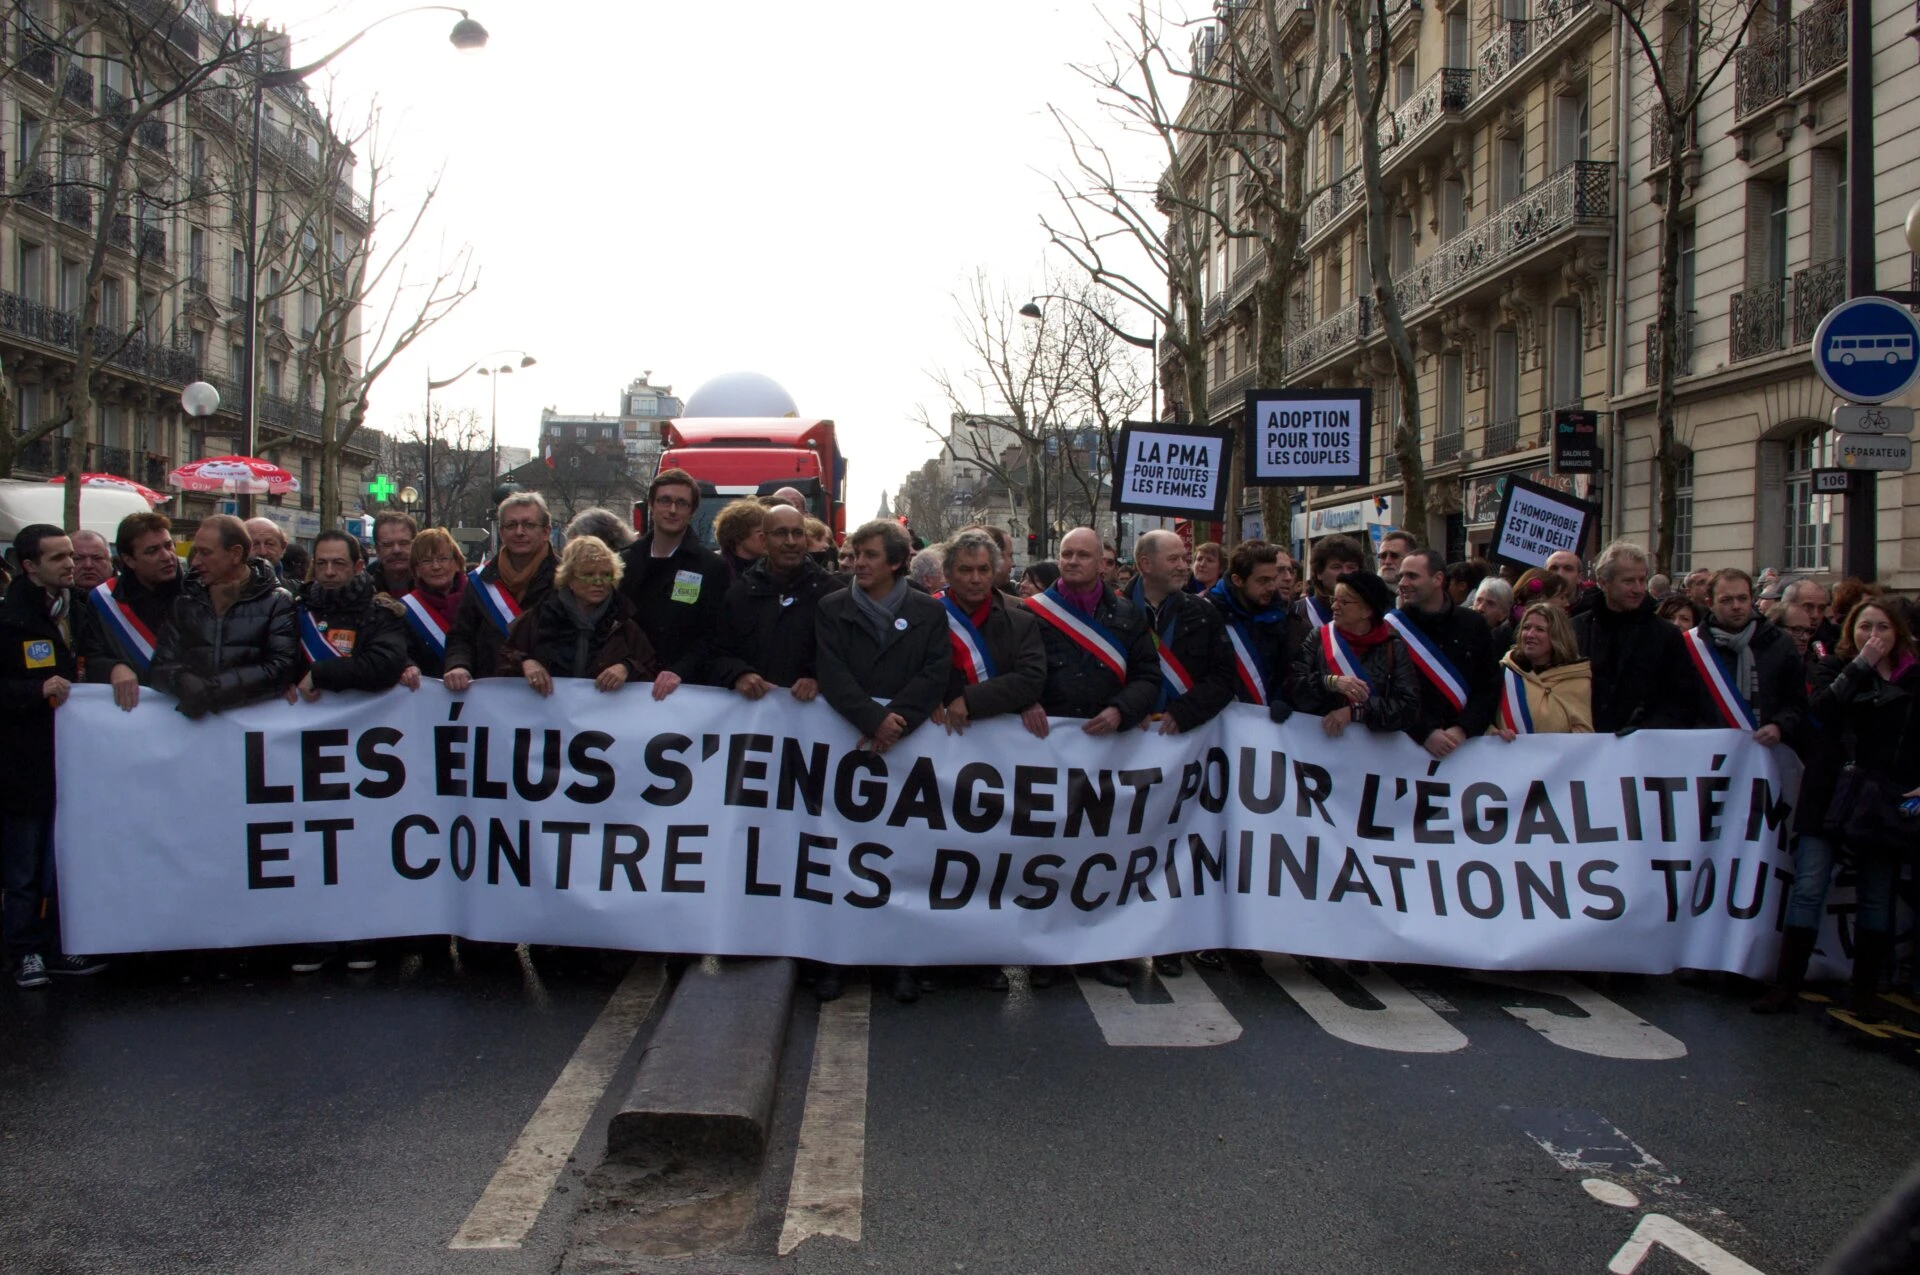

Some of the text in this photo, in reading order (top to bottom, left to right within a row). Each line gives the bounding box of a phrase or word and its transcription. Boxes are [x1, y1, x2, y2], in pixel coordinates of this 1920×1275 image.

[1267, 410, 1350, 429] ADOPTION
[1267, 432, 1350, 449] POUR TOUS
[1137, 441, 1209, 467] LA PMA
[1267, 450, 1350, 465] LES COUPLES
[1844, 445, 1906, 457] SÉPARATEUR
[1133, 464, 1209, 483] POUR TOUTES
[1822, 475, 1846, 486] 106
[1131, 478, 1207, 499] LES FEMMES
[1513, 500, 1578, 533] L'HOMOPHOBIE
[1505, 533, 1521, 547] PAS
[1521, 540, 1537, 553] UNE
[1508, 516, 1575, 550] EST UN DÉLIT
[244, 727, 406, 804] LES
[433, 701, 617, 804] ÉLUS
[639, 732, 1163, 838] S'ENGAGENT
[1168, 746, 1336, 825] POUR
[1356, 753, 1731, 845] L'ÉGALITÉ
[246, 817, 355, 891] ET
[390, 814, 710, 894] CONTRE
[744, 825, 894, 910] LES
[928, 829, 1627, 921] DISCRIMINATIONS
[1650, 856, 1796, 933] TOUT
